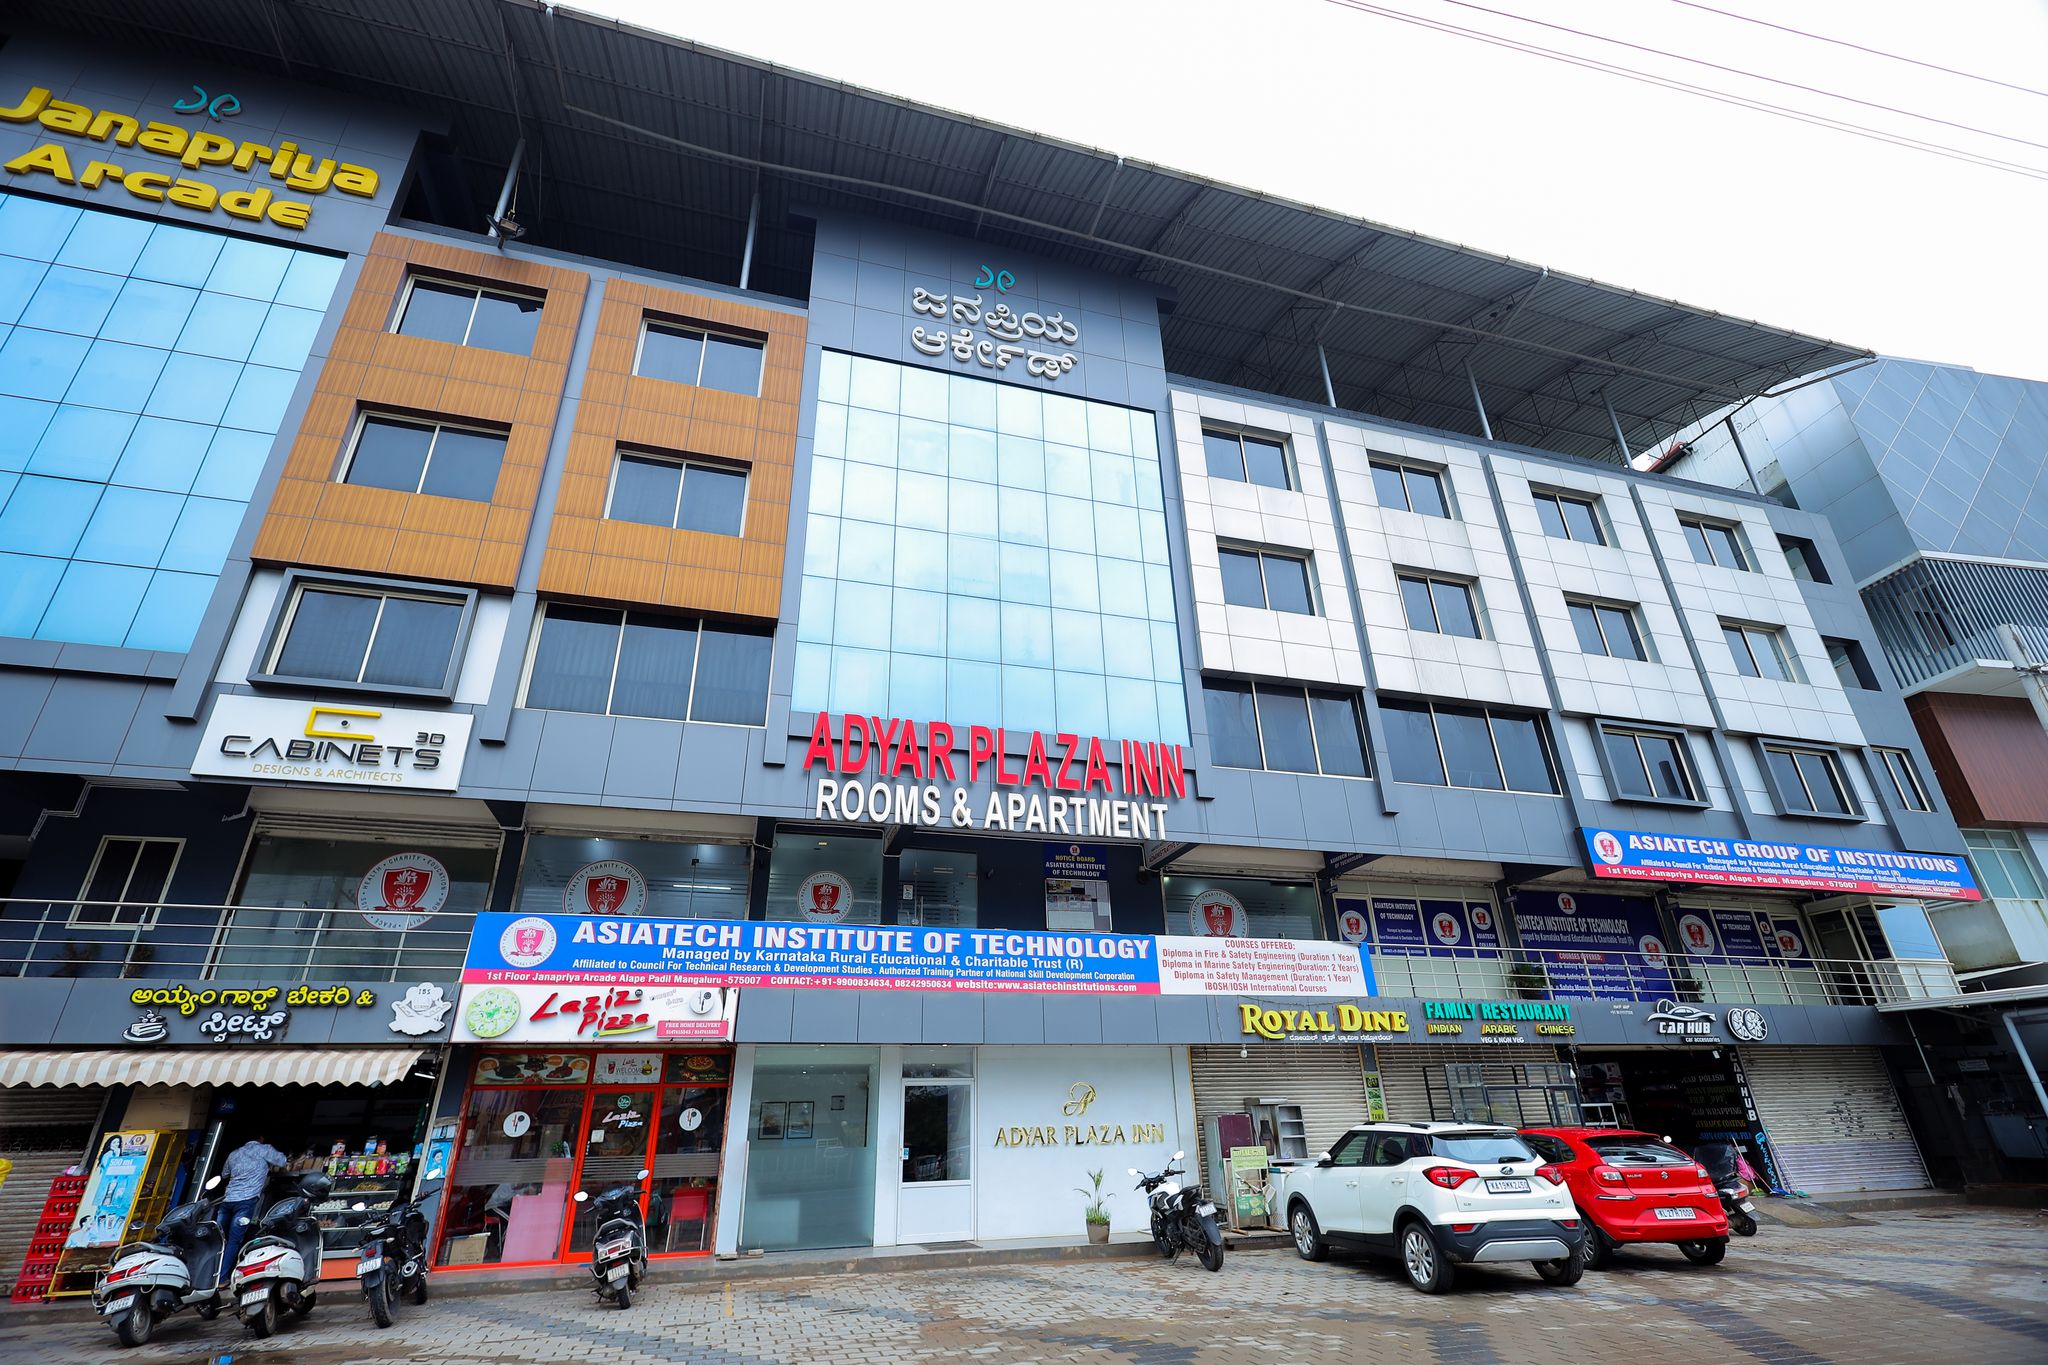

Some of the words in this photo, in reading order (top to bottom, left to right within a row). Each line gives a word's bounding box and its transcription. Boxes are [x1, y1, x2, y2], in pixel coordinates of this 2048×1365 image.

[0, 86, 379, 198] Janapriya
[3, 143, 312, 231] Arcade
[912, 287, 1079, 345] ಜನಪ್ರಿಯ
[415, 731, 446, 746] 3D
[220, 735, 442, 770] CABINETS
[802, 711, 956, 782] ADYAR
[969, 724, 1113, 793] PLAZA
[1120, 738, 1187, 799] INN
[252, 763, 311, 777] DESIGNS
[314, 767, 323, 778] &
[327, 768, 403, 782] ARCHITECTS
[815, 778, 941, 826] ROOMS
[951, 787, 974, 828] &
[983, 790, 1169, 841] APARTMENT
[388, 854, 420, 864] CHARITY
[1630, 834, 1730, 856] ASIATECH
[1733, 842, 1801, 861] GROUP
[1805, 847, 1831, 863] OF
[1835, 850, 1959, 873] INSTITUTIONS
[363, 866, 381, 889] HEALTH
[427, 859, 447, 890] EDUCATION
[589, 862, 618, 872] CHARITY
[1623, 867, 1648, 876] Floor,
[1650, 869, 1692, 879] Janapriya
[1782, 878, 1824, 887] Mangaluru
[569, 874, 585, 896] HEALTH
[1516, 914, 1545, 931] SIATECH
[572, 921, 742, 948] ASIATECH
[753, 926, 913, 952] INSTITUTE
[923, 931, 961, 953] OF
[970, 934, 1150, 959] TECHNOLOGY
[1225, 940, 1259, 949] COURSES
[1260, 941, 1295, 950] OFFERED:
[662, 947, 729, 961] Managed
[734, 950, 751, 962] by
[756, 950, 825, 963] Karnataka
[831, 952, 866, 963] Rural
[871, 953, 946, 966] Educational
[951, 955, 960, 966] &
[965, 956, 1028, 968] Charitable
[1032, 958, 1062, 969] Trust
[1066, 958, 1084, 971] (R)
[1162, 949, 1193, 959] Diploma
[1195, 950, 1202, 958] in
[1204, 950, 1218, 958] Fire
[1221, 950, 1226, 958] &
[1229, 951, 1251, 960] Safety
[1254, 951, 1296, 961] Engineering
[1298, 952, 1329, 961] (Duration
[1332, 953, 1335, 961] 1
[1337, 953, 1356, 962] Year)
[573, 959, 615, 969] Affiliated
[618, 960, 627, 969] to
[630, 960, 665, 970] Council
[668, 962, 683, 971] For
[685, 962, 727, 971] Technical
[730, 962, 771, 972] Research
[774, 963, 781, 972] &
[784, 963, 839, 974] Development
[842, 966, 872, 974] Studies
[879, 967, 921, 976] Authorized
[923, 967, 954, 977] Training
[956, 969, 983, 977] Partner
[986, 969, 994, 977] of
[996, 970, 1026, 978] National
[1028, 970, 1043, 978] Skill
[1046, 971, 1092, 980] Development
[1094, 972, 1135, 980] Corporation
[1162, 960, 1192, 969] Diploma
[1195, 960, 1202, 968] in
[1204, 960, 1230, 969] Marine
[1232, 961, 1255, 971] Safety
[1331, 964, 1336, 972] 2
[1337, 964, 1359, 973] Years)
[1174, 970, 1204, 980] Diploma
[1207, 971, 1214, 979] in
[1216, 971, 1239, 982] Safety
[1241, 972, 1288, 982] Management
[1291, 973, 1325, 982] (Duration:
[1327, 974, 1331, 982] 1
[1333, 974, 1352, 983] Year)
[487, 972, 501, 980] 1st
[504, 972, 530, 981] Floor
[532, 972, 580, 982] Janapriya
[583, 974, 616, 982] Arcade
[619, 974, 645, 983] Alape
[648, 974, 671, 982] Padil
[673, 975, 721, 985] Mangaluru
[724, 976, 761, 984] -575007
[894, 979, 952, 988] 08242950634
[1250, 983, 1297, 992] International
[1299, 984, 1328, 992] Courses
[286, 985, 350, 1005] ಬೇಕರಿ
[355, 990, 375, 1006] &
[529, 987, 642, 1022] Laziz
[1239, 1003, 1336, 1039] ROYAL
[1336, 1004, 1410, 1032] DINE
[1423, 1002, 1476, 1020] FAMILY
[1479, 1003, 1572, 1021] RESTAURANT
[577, 1011, 650, 1036] Pizza
[1427, 1023, 1463, 1034] INDIAN
[1482, 1023, 1518, 1034] ARABIC
[1536, 1023, 1575, 1035] CHINESE
[1659, 1021, 1684, 1034] CAR
[1687, 1021, 1710, 1034] HUB
[618, 1119, 644, 1129] Pizza
[994, 1126, 1059, 1147] ADYAR
[1064, 1124, 1126, 1145] PLAZA
[1132, 1123, 1165, 1144] INN
